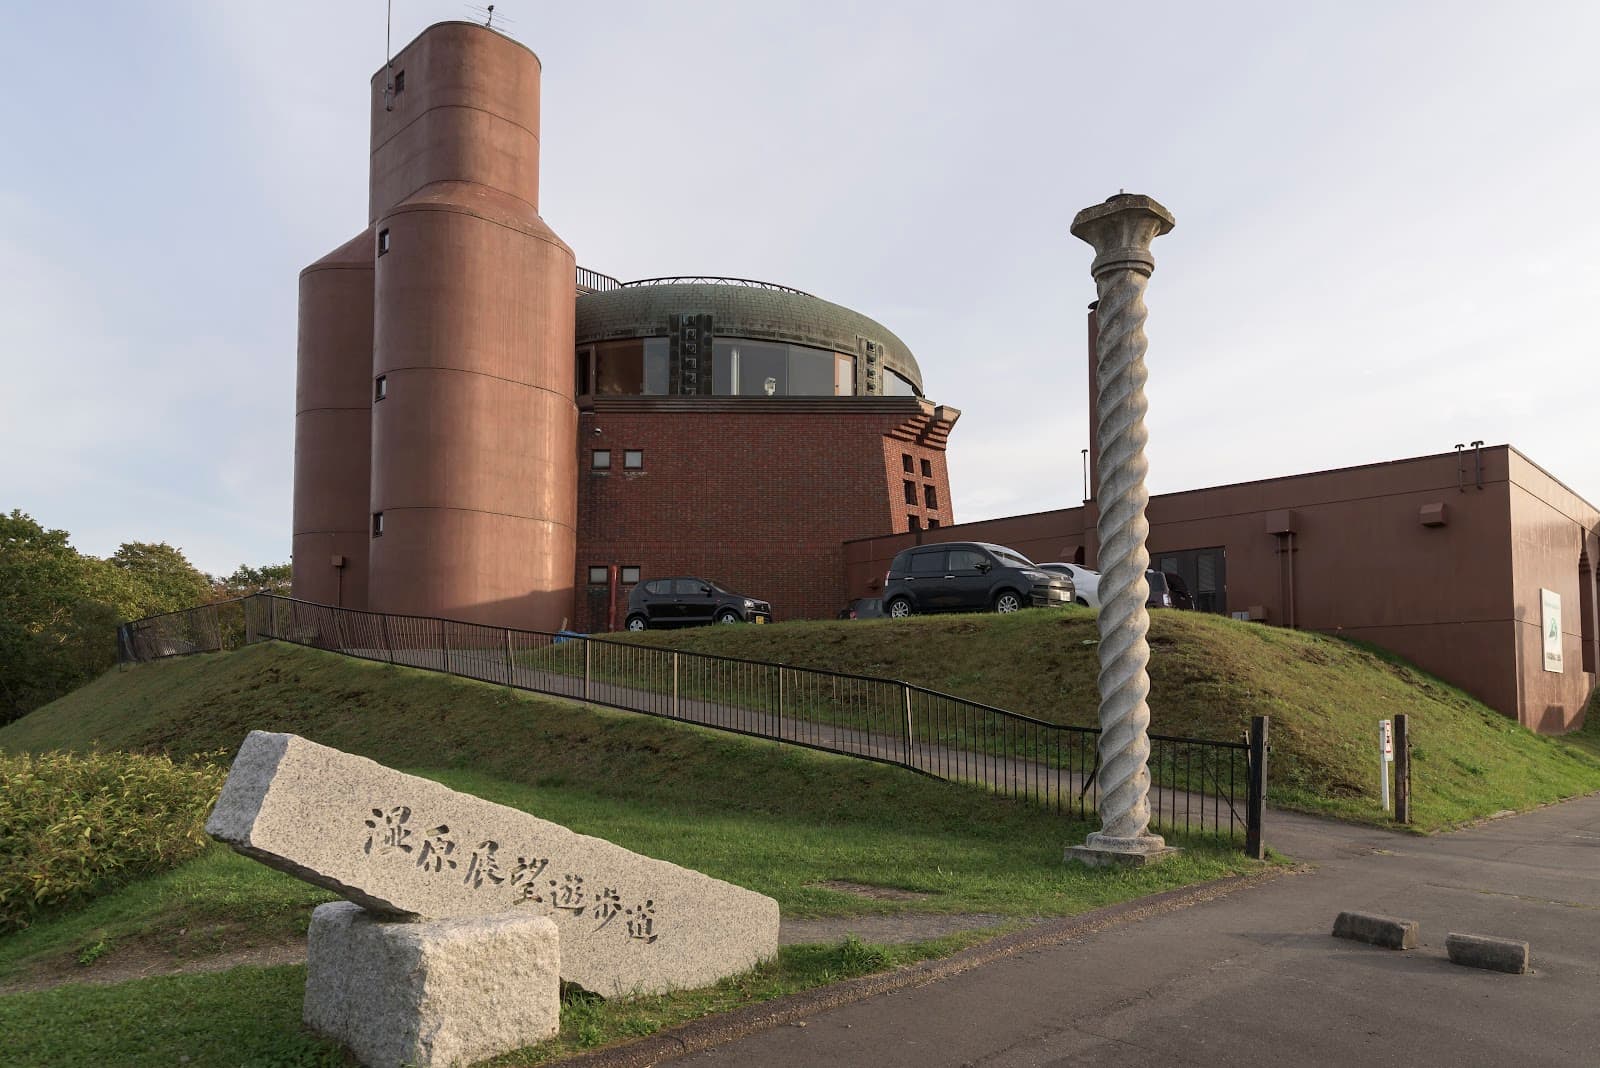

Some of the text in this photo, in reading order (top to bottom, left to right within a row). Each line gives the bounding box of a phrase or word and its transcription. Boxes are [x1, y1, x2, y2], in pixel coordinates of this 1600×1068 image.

[364, 806, 658, 944] 湿原展望遊歩道
